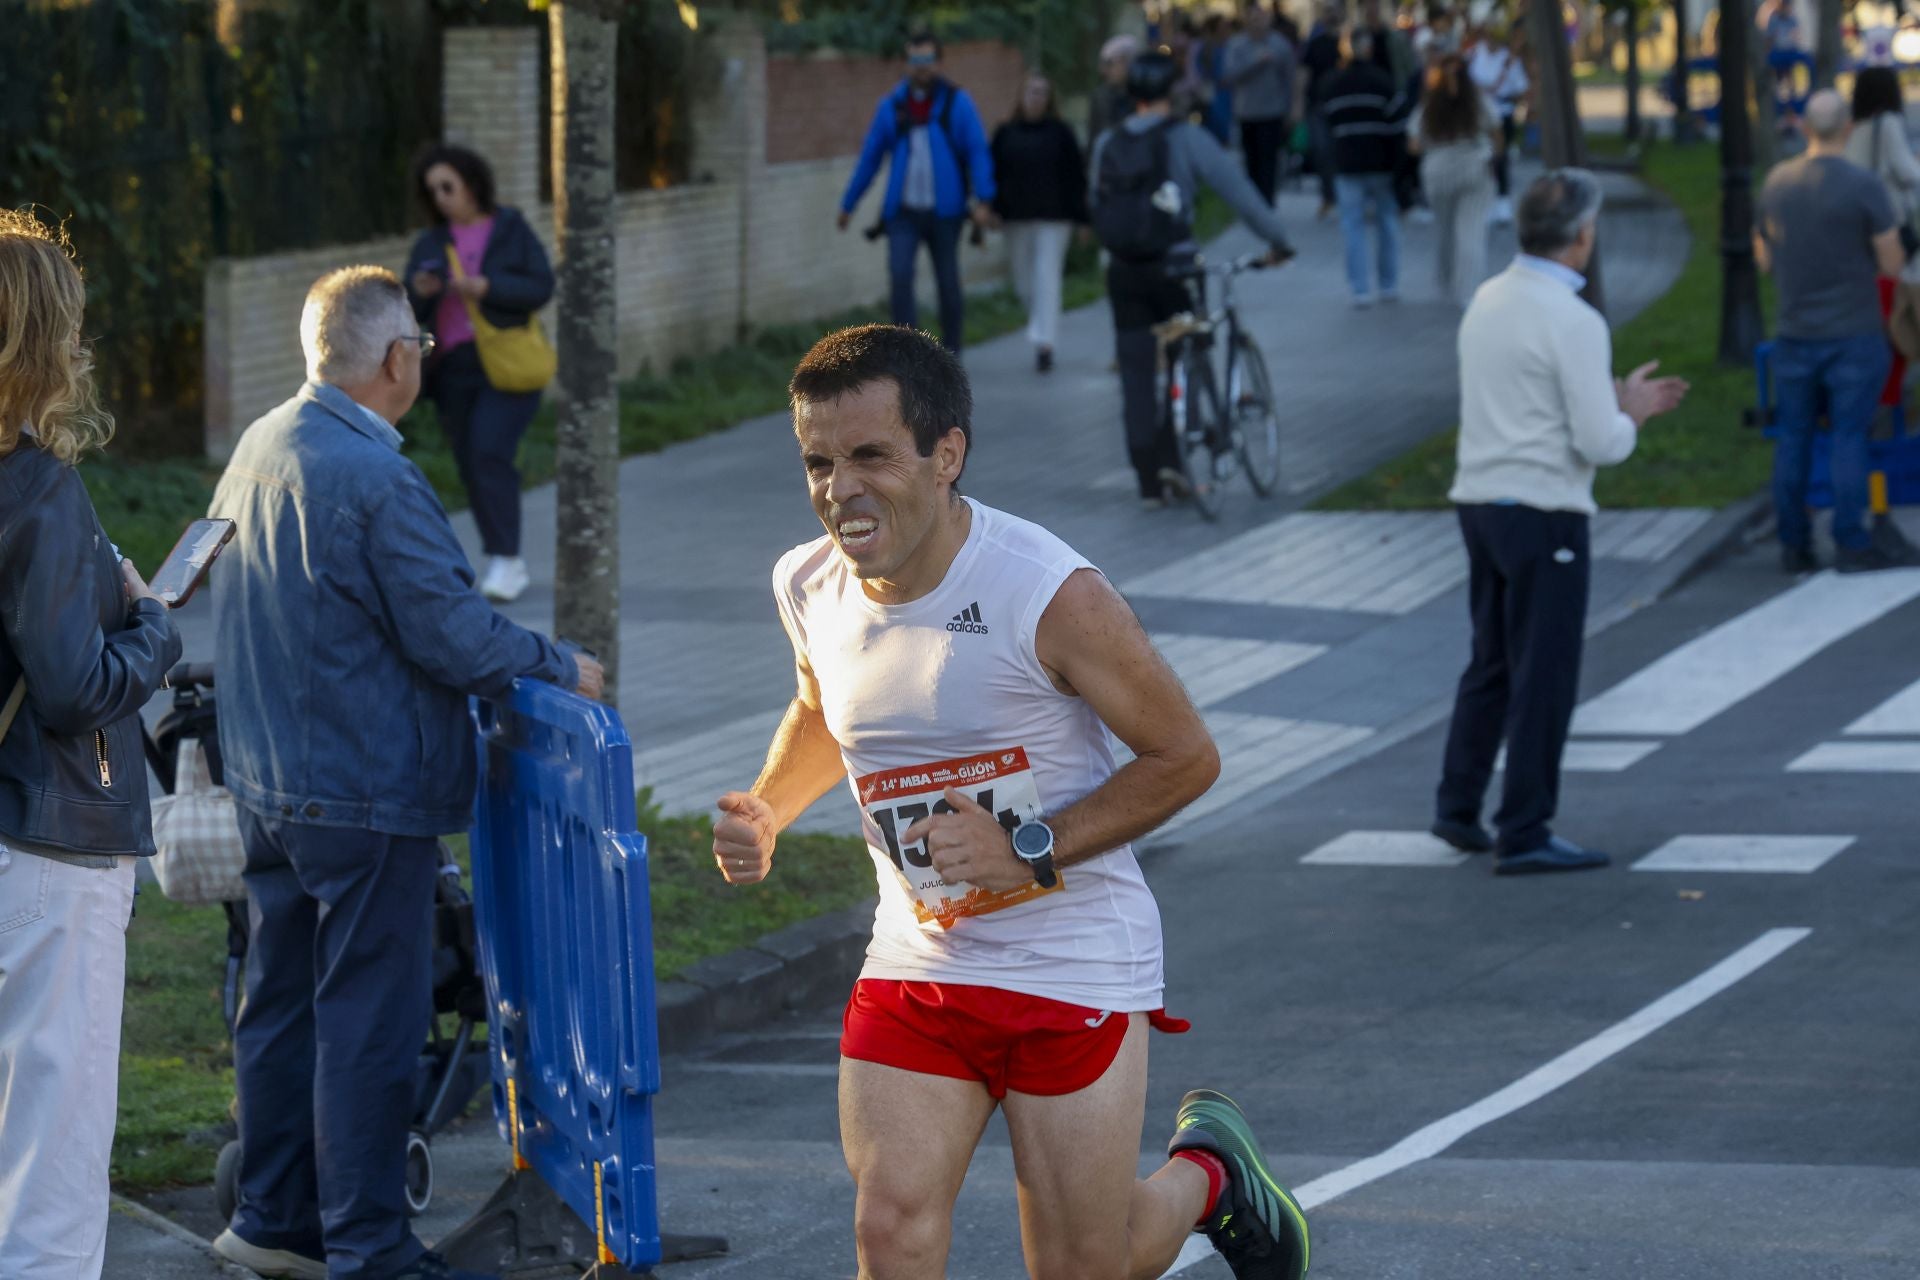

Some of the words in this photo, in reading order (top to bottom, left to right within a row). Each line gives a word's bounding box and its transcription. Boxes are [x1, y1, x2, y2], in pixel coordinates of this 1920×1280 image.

[946, 620, 989, 635] adidas
[932, 768, 951, 778] media
[958, 761, 996, 779] GIJÓN
[900, 772, 932, 789] MBA
